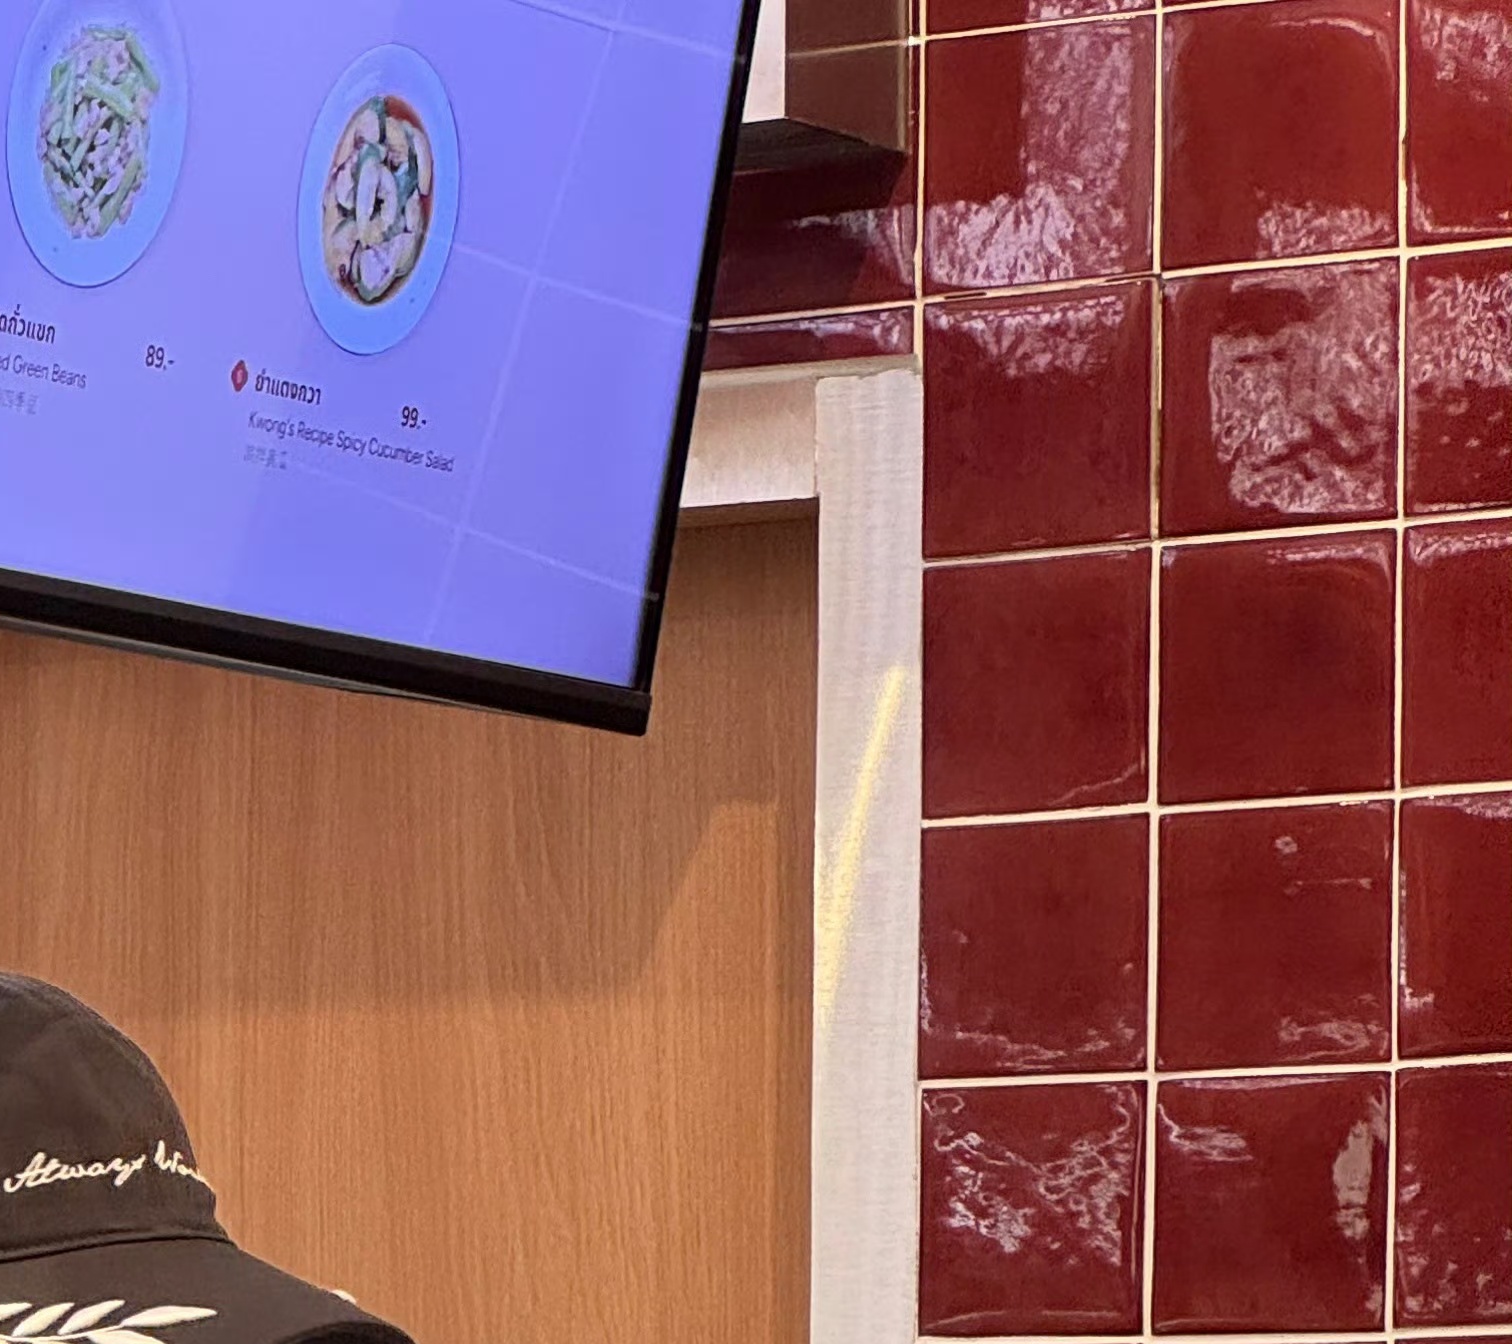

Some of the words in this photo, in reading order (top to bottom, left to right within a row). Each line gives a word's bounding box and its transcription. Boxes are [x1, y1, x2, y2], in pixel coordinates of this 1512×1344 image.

[13, 354, 49, 380] Green
[51, 363, 88, 389] Beans
[255, 368, 322, 405] ยำแตงกวา
[248, 410, 294, 439] Kwong's
[297, 420, 335, 448] Recipe
[337, 430, 367, 457] Spicy
[369, 437, 425, 465] Cucumber
[425, 449, 455, 473] Salad
